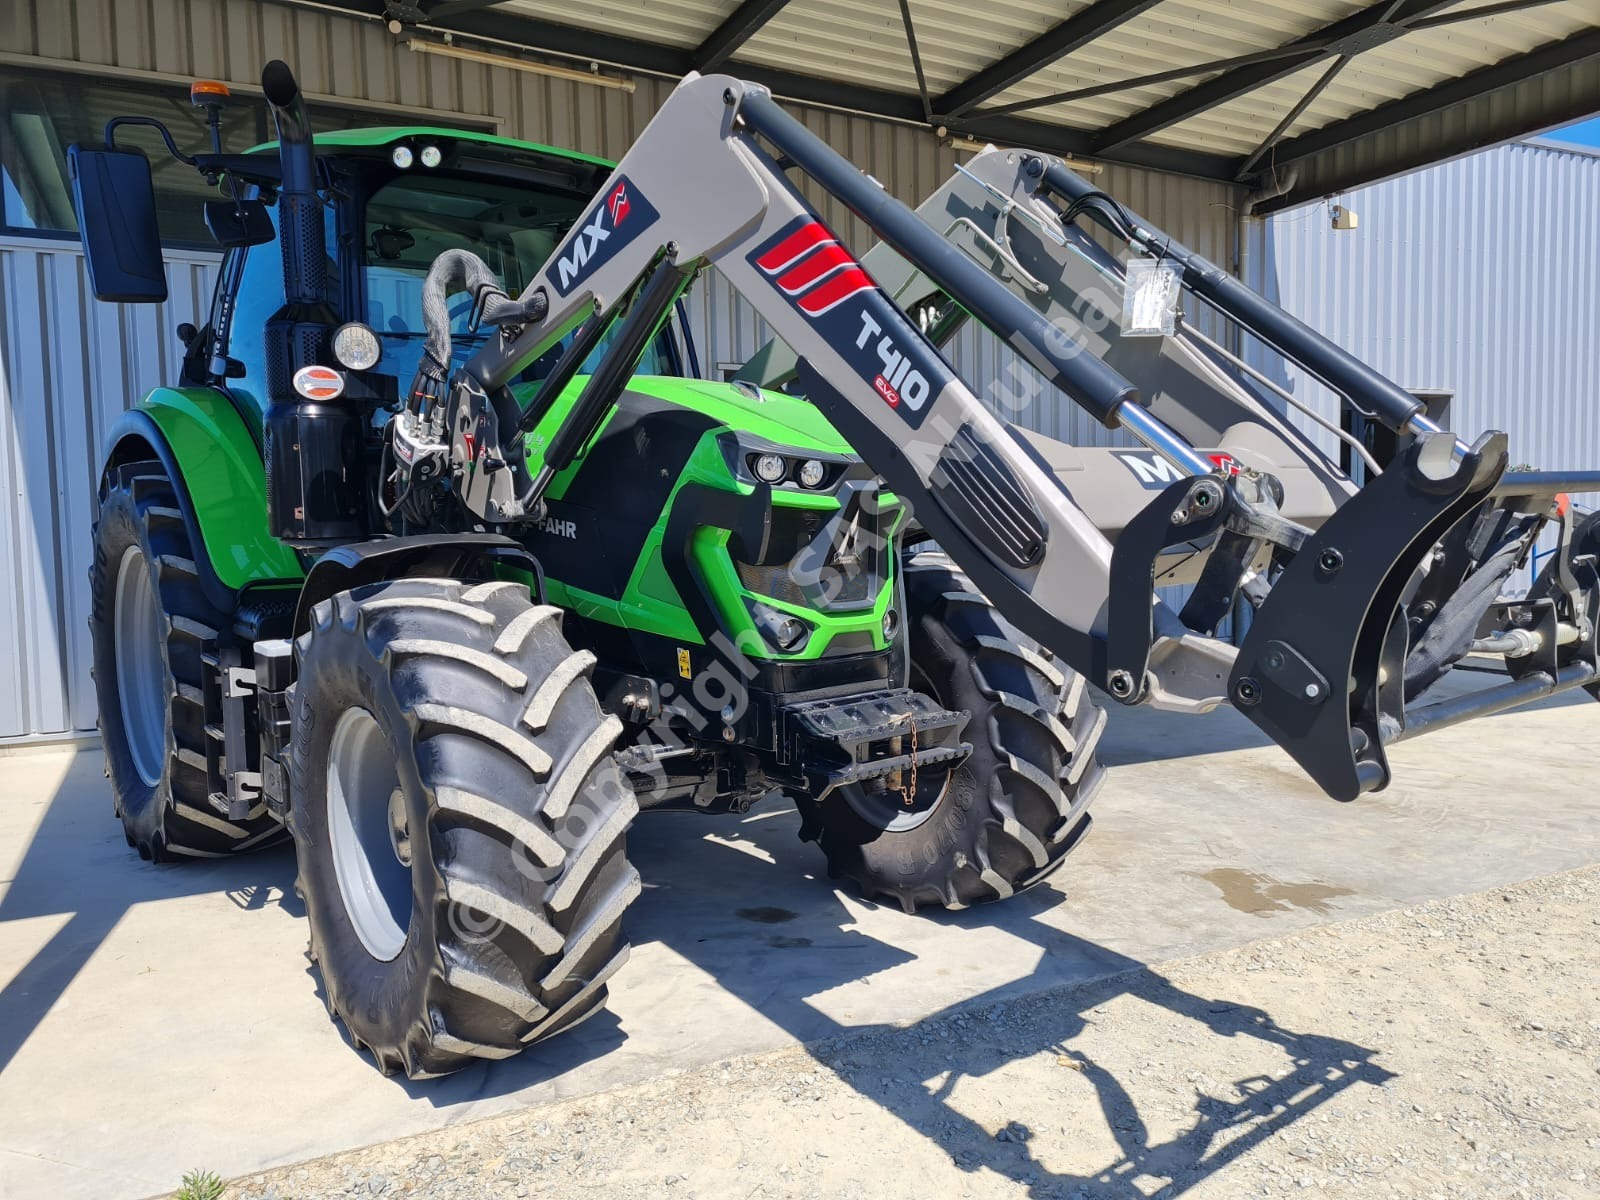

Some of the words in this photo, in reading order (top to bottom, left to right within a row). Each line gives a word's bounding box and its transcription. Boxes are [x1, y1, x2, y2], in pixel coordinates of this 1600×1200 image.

[557, 204, 611, 290] MX
[855, 309, 930, 412] T410
[874, 377, 899, 404] EVO
[1120, 455, 1187, 482] M
